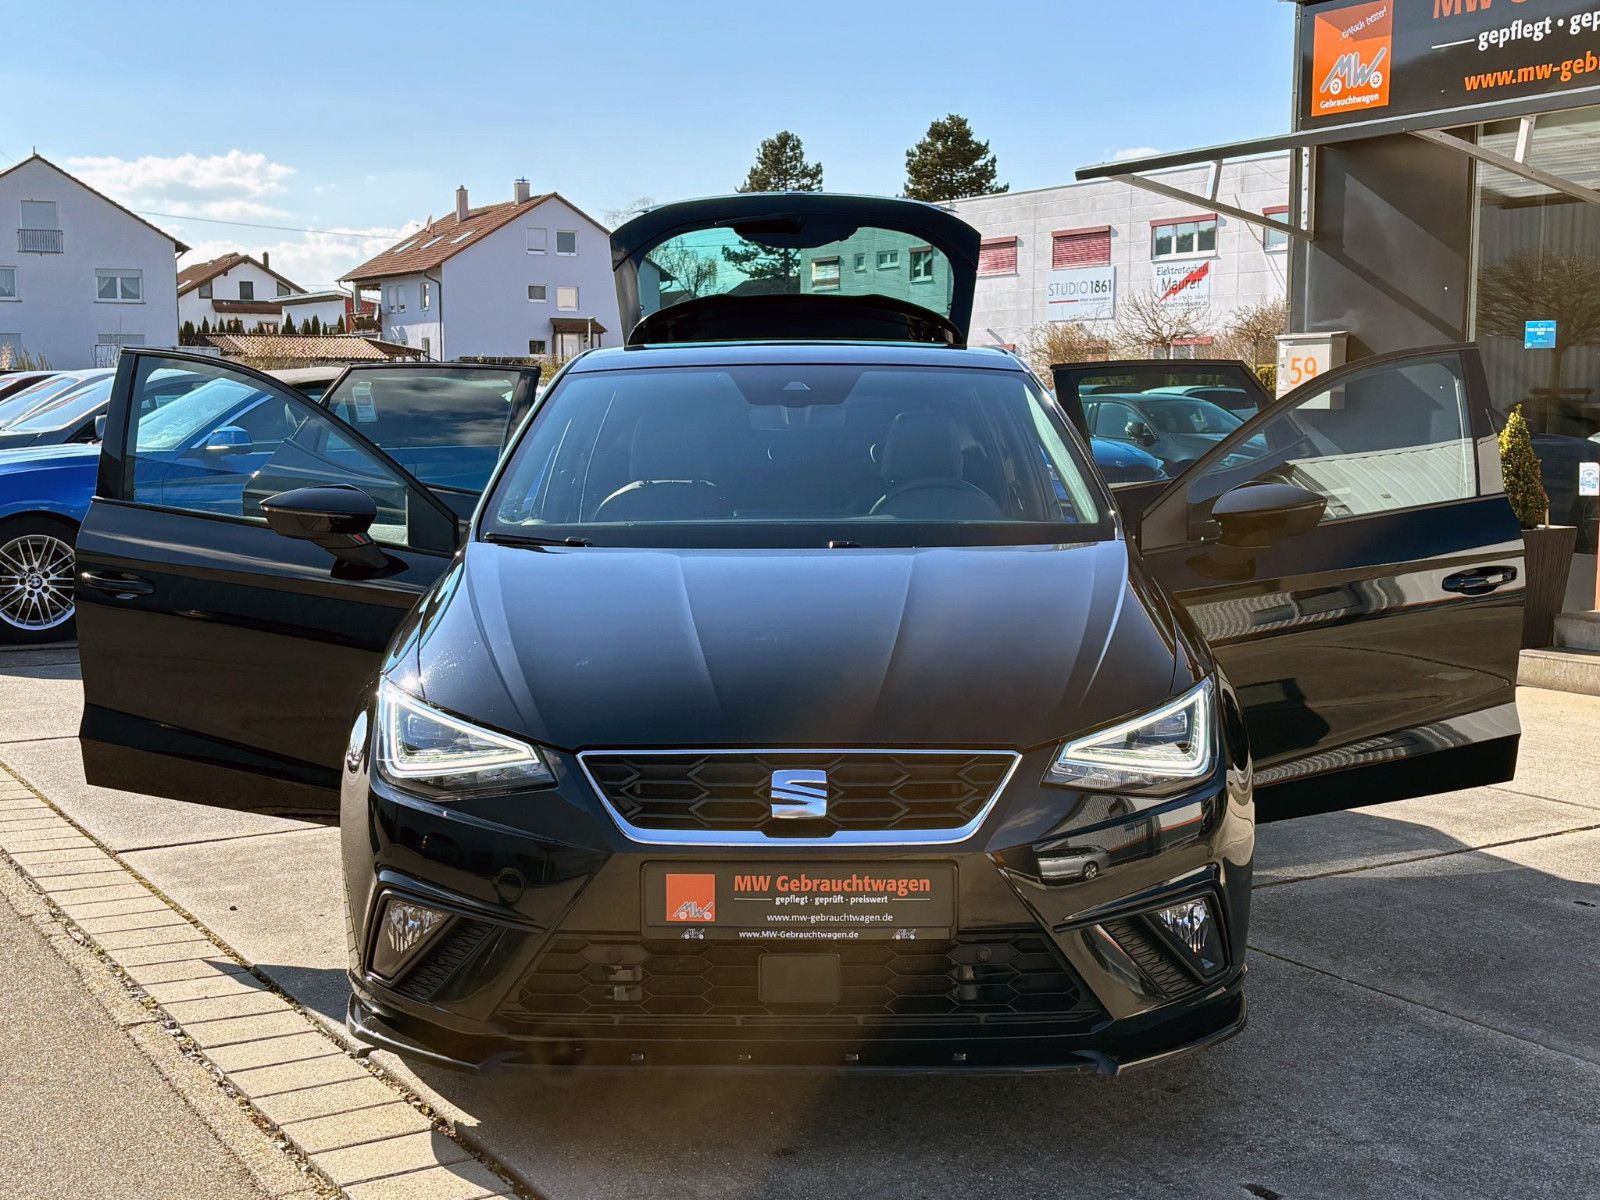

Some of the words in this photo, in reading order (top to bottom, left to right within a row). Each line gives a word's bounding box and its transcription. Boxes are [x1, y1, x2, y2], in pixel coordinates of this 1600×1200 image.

[1477, 16, 1552, 51] gepflegt
[1320, 47, 1387, 95] MW
[1464, 50, 1600, 91] www.mw-geb
[1320, 93, 1380, 109] Gebrauchtwagen
[1048, 280, 1089, 297] STUDIO
[1090, 279, 1112, 294] 1861
[1161, 277, 1203, 292] Maurer
[1289, 355, 1318, 385] 59
[734, 875, 771, 892] MW
[776, 874, 931, 896] Gebrauchtwagen
[775, 895, 808, 905] gepflegt
[815, 895, 844, 905] geprüft
[850, 895, 889, 905] preiswert
[767, 913, 893, 923] www.mw-gebrauchtwagen.de
[739, 930, 859, 940] www.MW-Gebrauchtwagen.de
